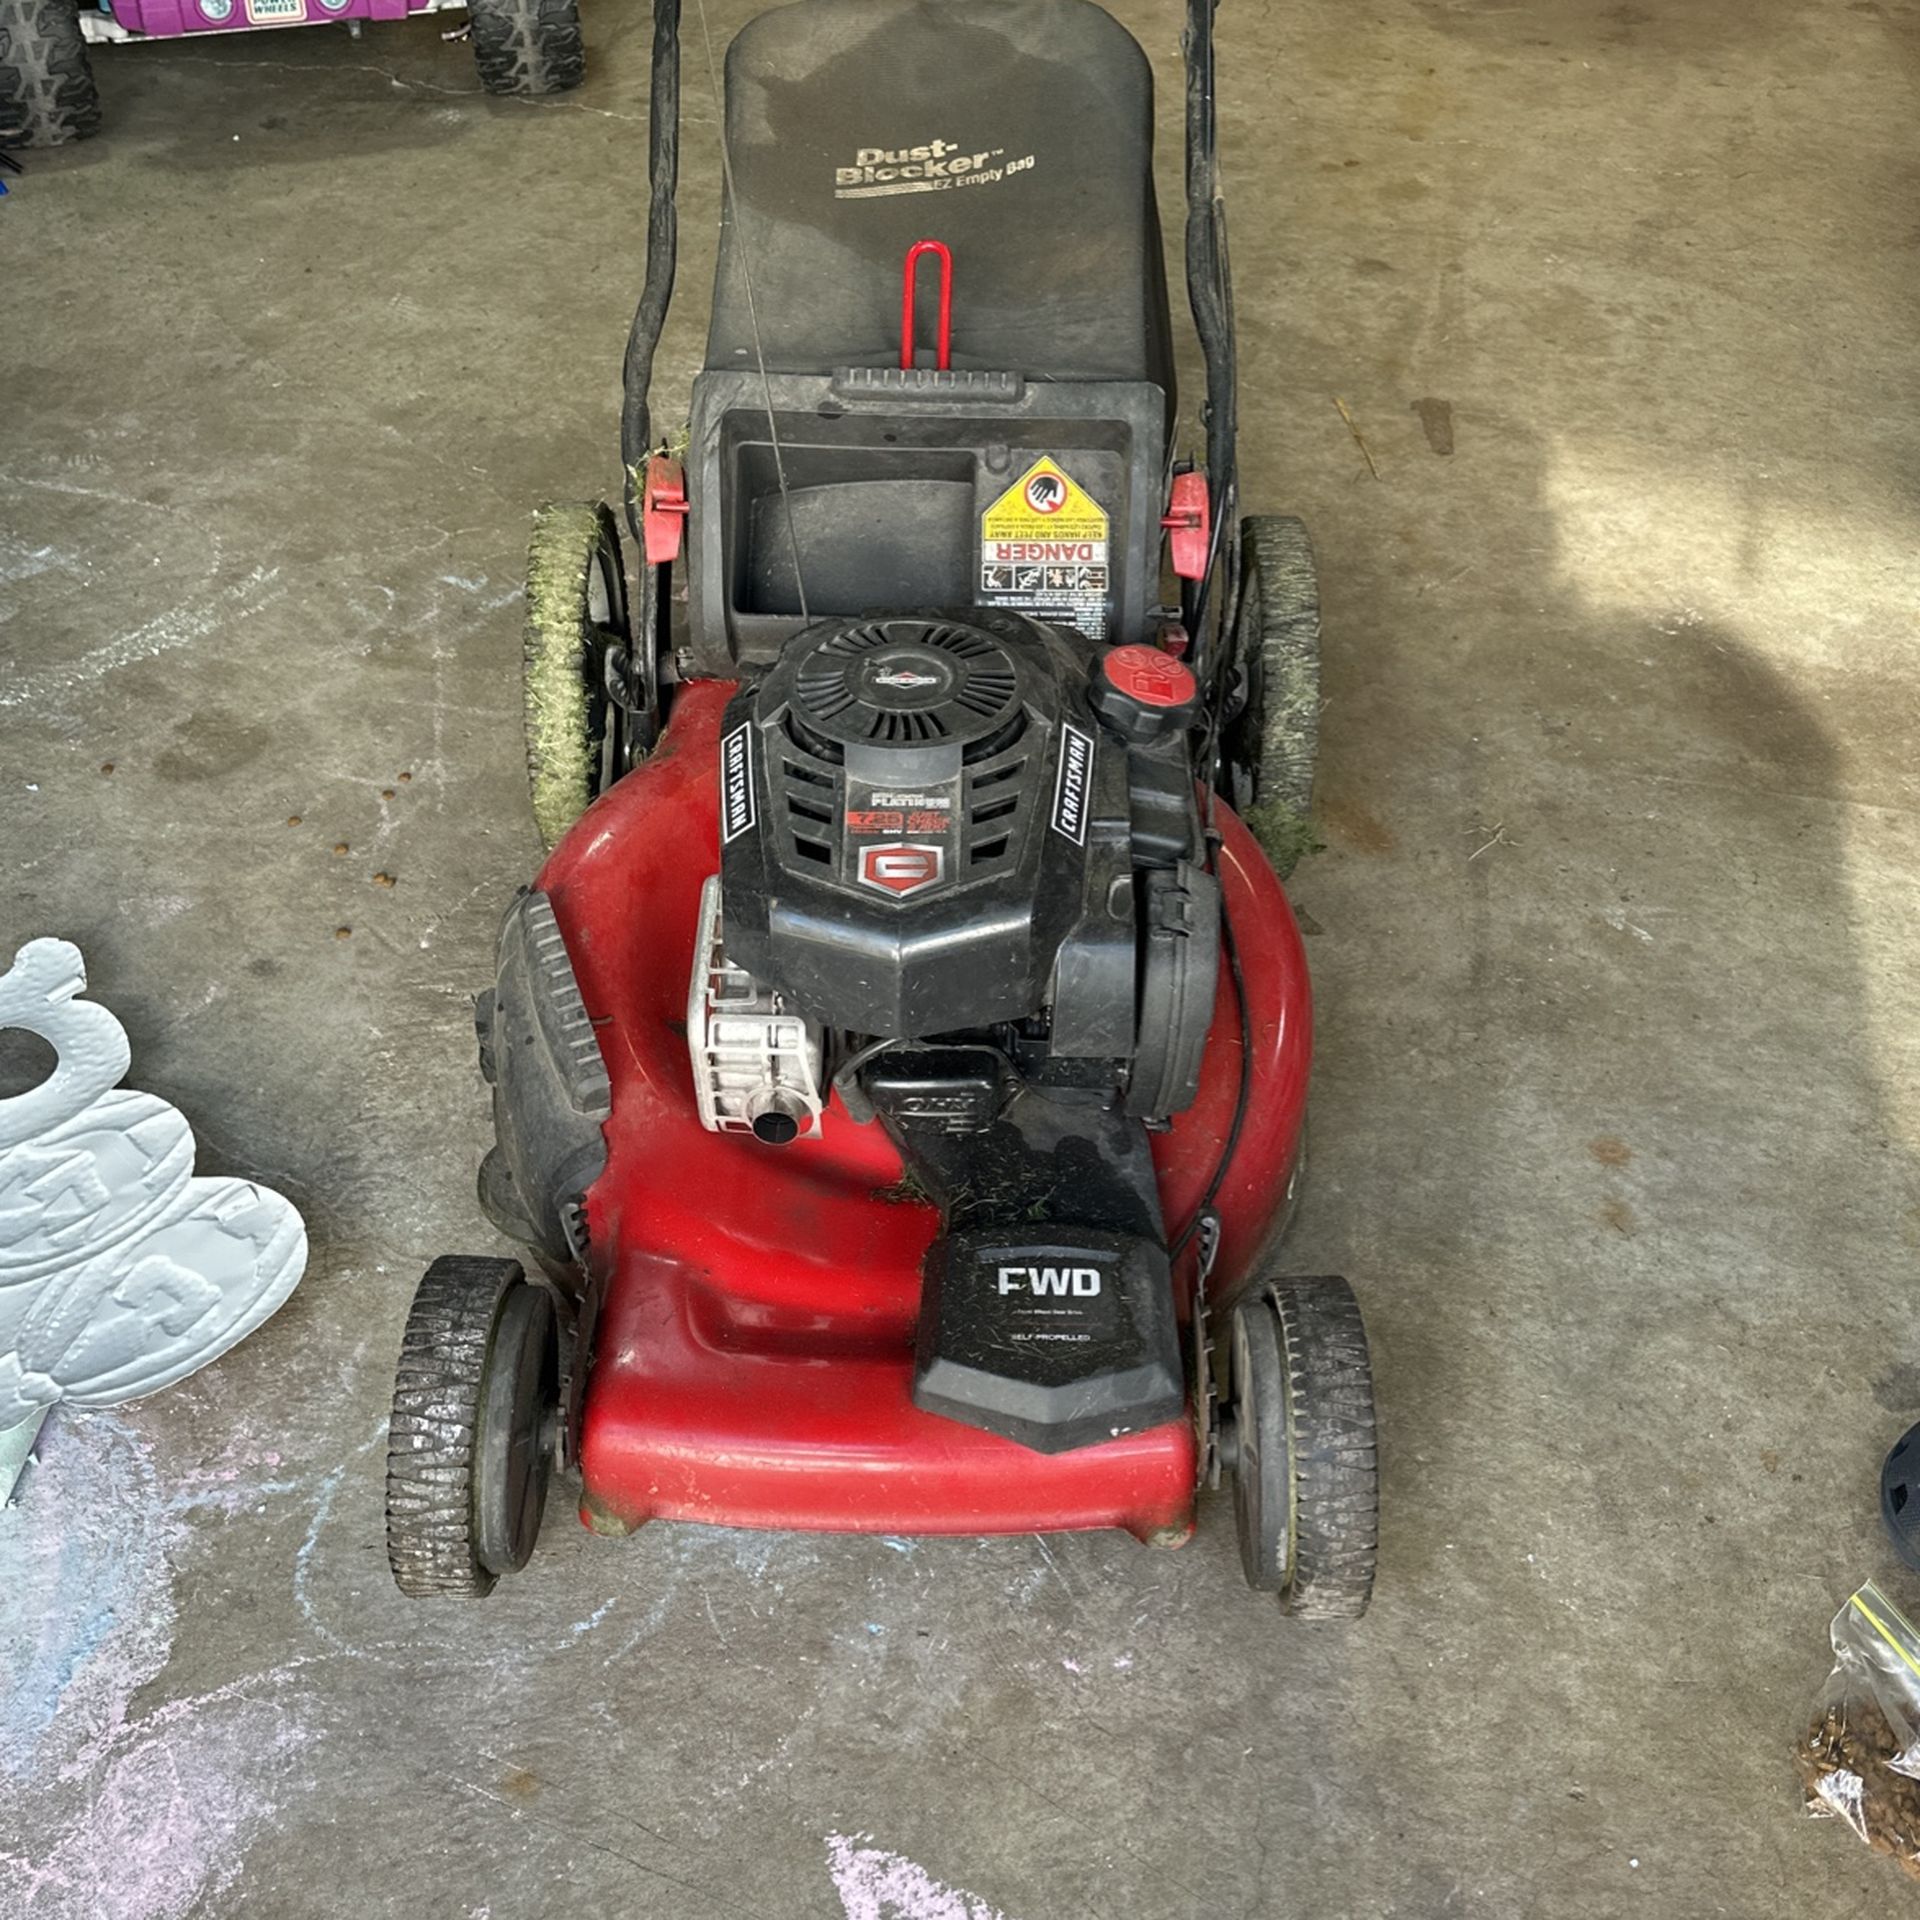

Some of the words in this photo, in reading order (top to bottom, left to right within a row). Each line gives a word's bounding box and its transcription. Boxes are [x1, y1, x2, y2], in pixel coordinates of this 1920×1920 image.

[254, 3, 297, 14] WHEELS
[856, 138, 958, 167] Dust-
[934, 178, 953, 191] EZ
[956, 167, 1003, 188] Empty
[1006, 154, 1036, 176] Bag
[996, 543, 1093, 561] DANGER
[728, 734, 748, 830] CRAFTSMAN
[1060, 735, 1086, 833] CRAFTSMAN
[997, 1267, 1102, 1297] FWD
